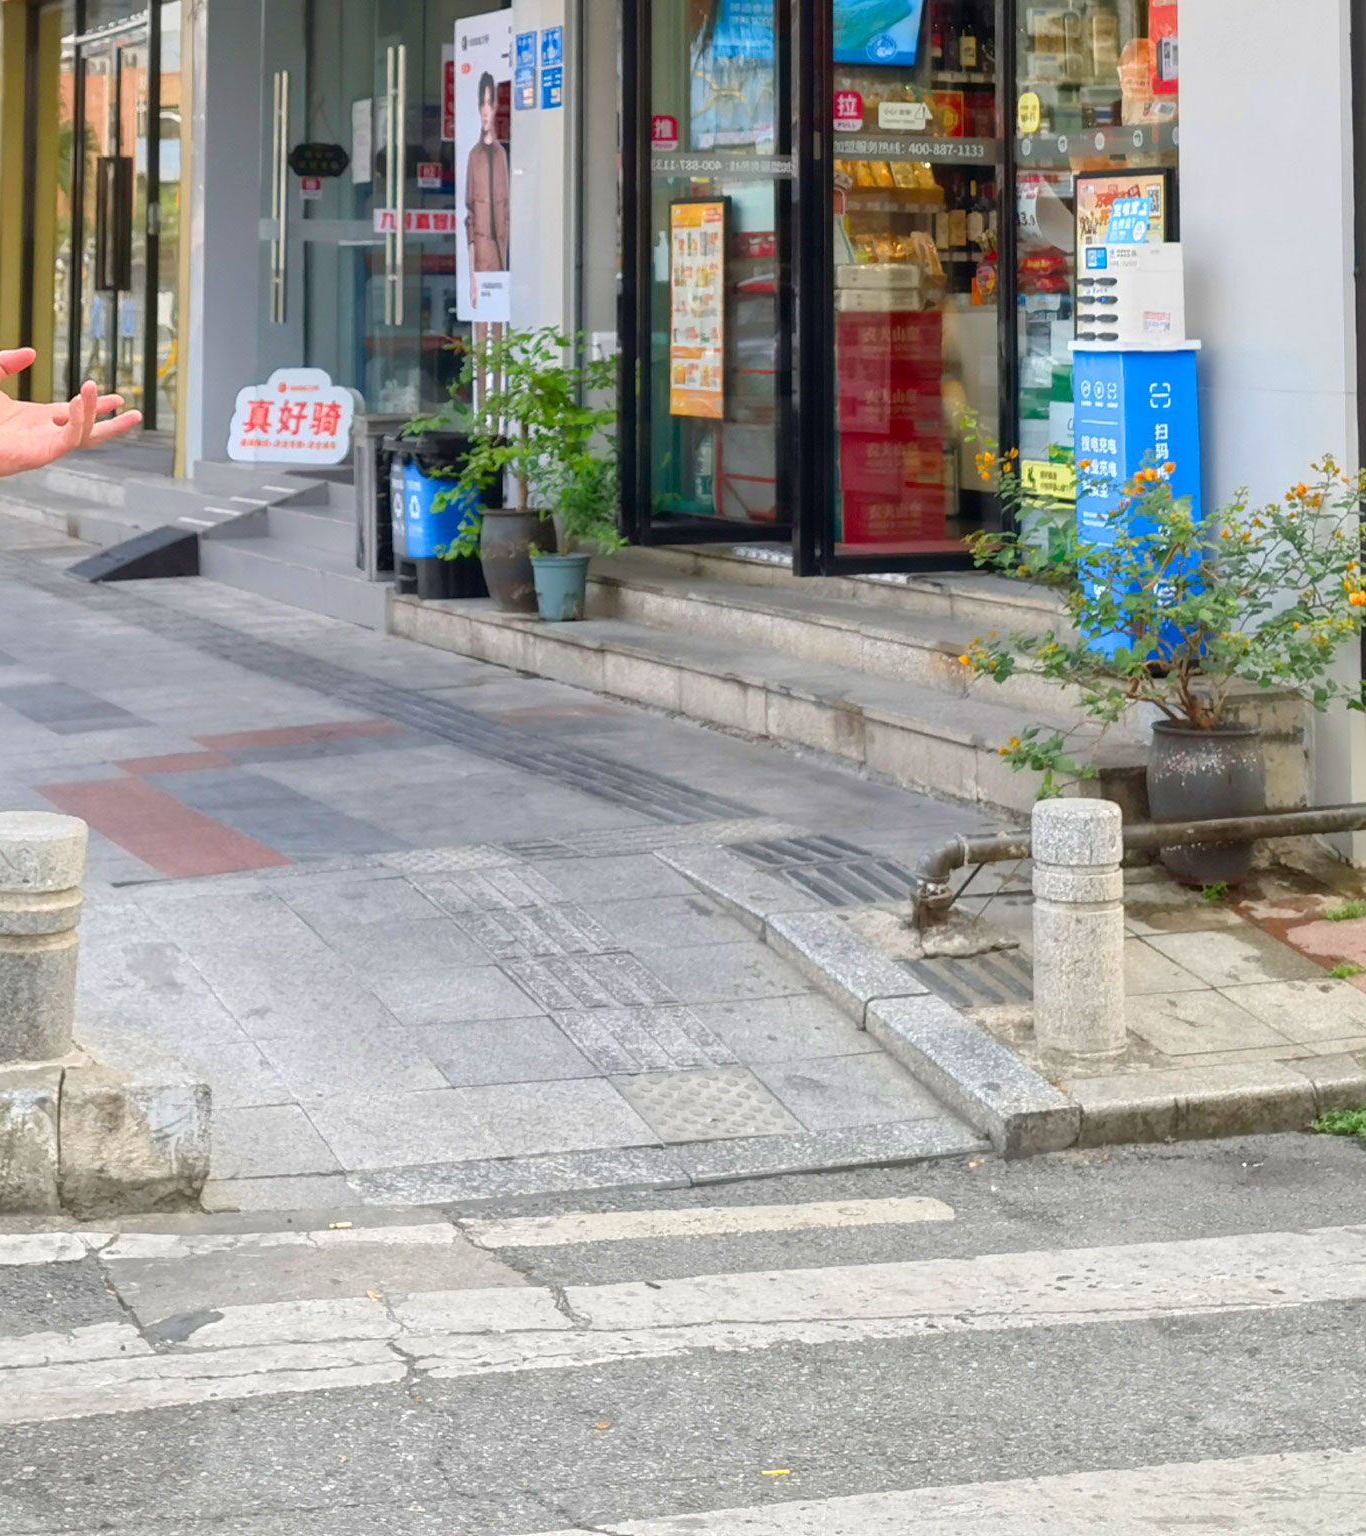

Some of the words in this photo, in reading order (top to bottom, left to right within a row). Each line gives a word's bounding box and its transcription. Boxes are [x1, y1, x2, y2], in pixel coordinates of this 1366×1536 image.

[837, 93, 858, 117] 拉
[655, 119, 673, 139] 推
[242, 399, 342, 437] 真好骑
